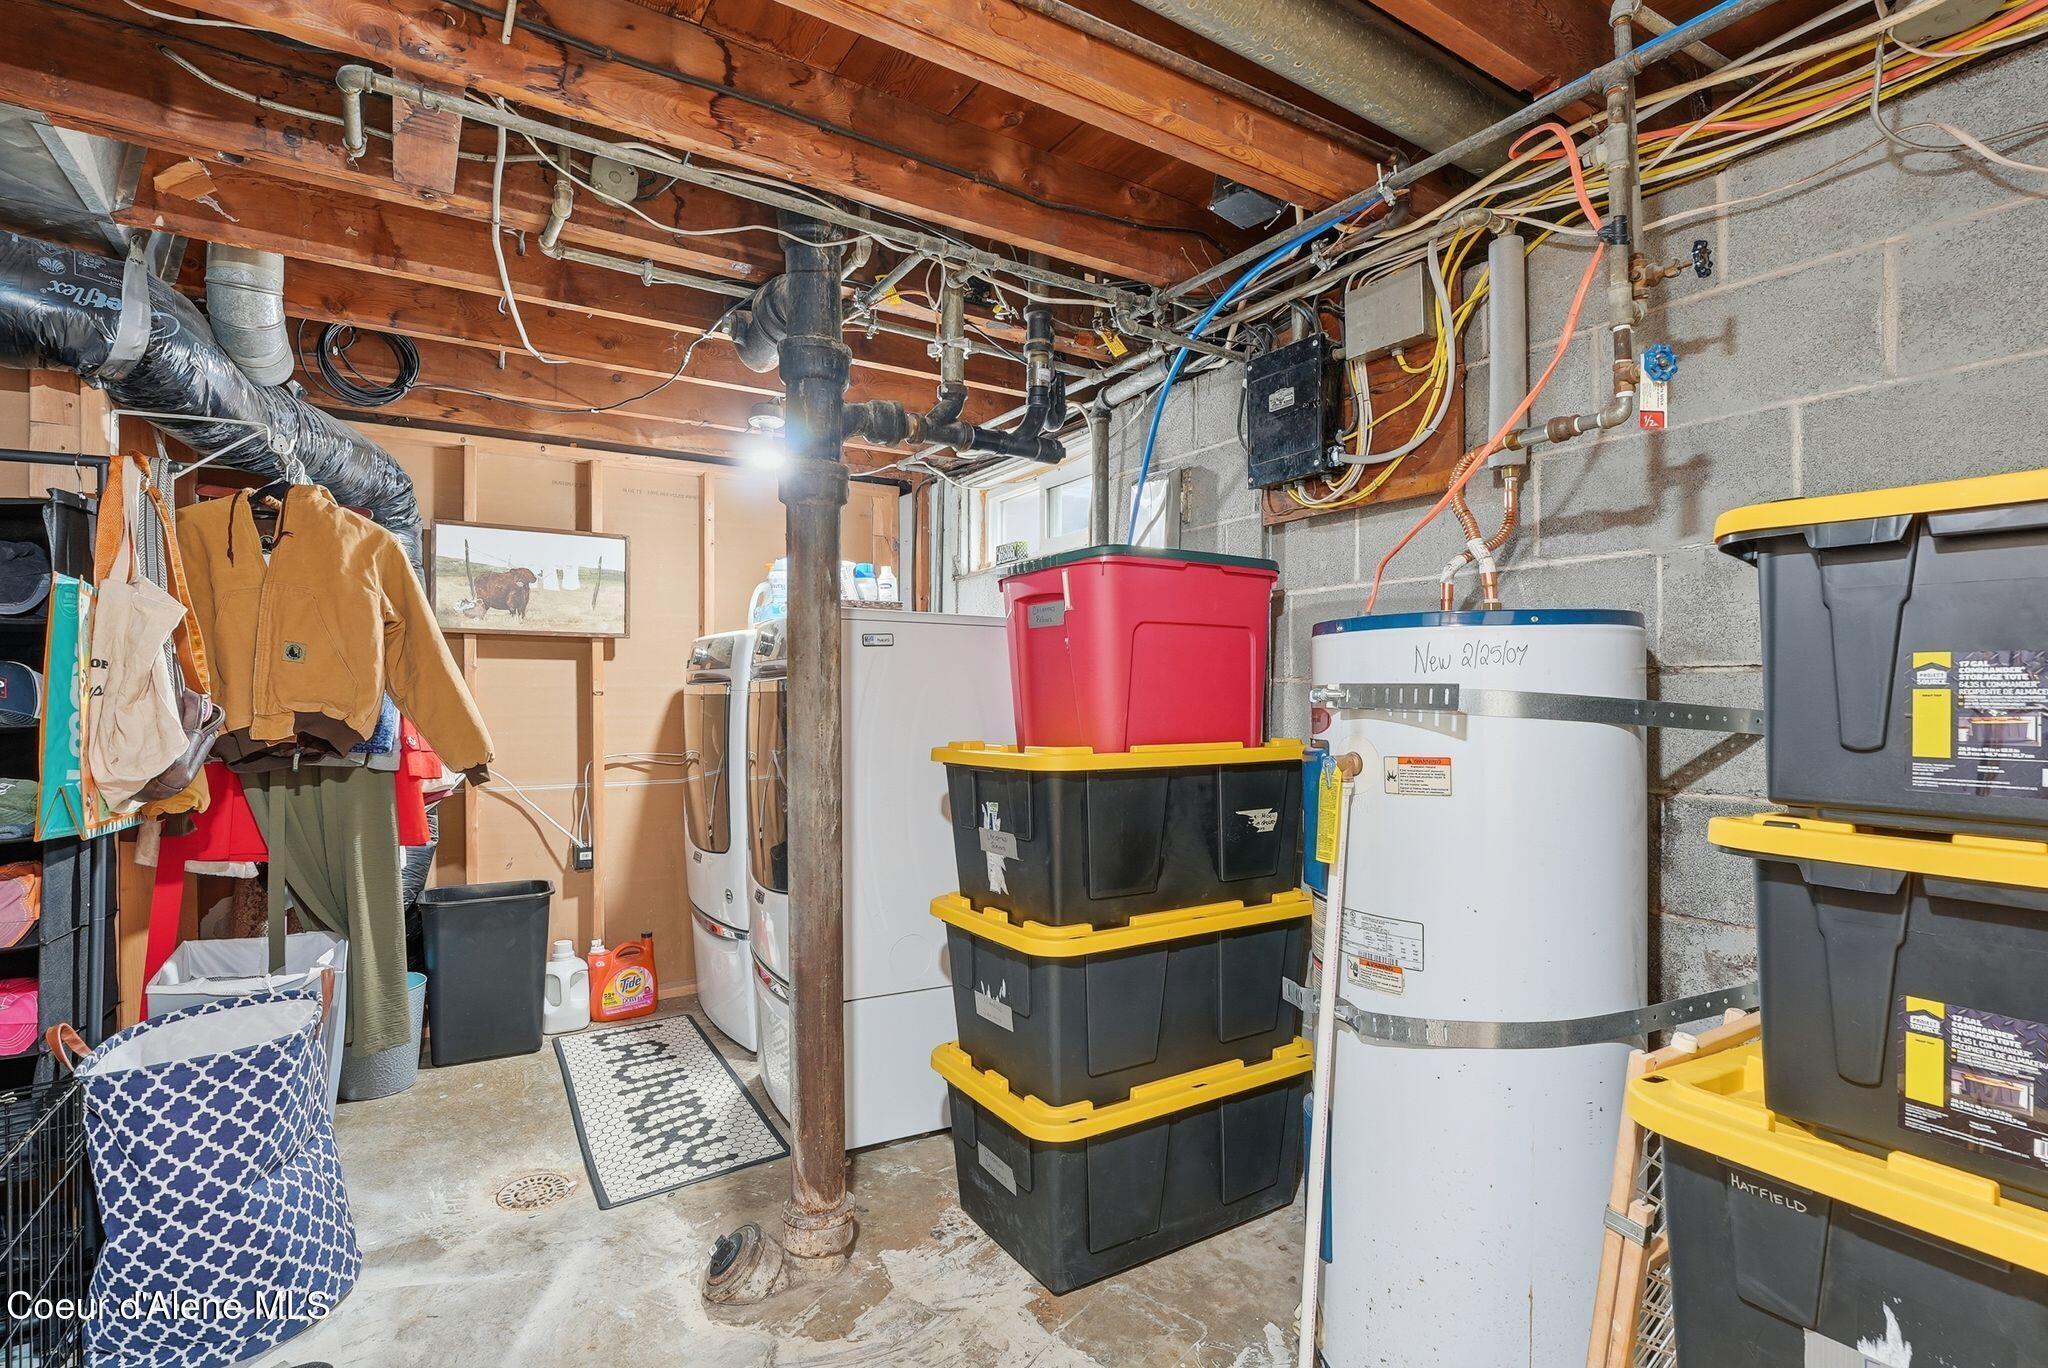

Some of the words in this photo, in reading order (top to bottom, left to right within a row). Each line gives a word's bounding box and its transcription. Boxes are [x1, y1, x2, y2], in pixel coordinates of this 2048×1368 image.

[1414, 641, 1452, 674] New
[1958, 666, 2024, 674] COMMANDER
[1958, 673, 2003, 681] STORAGE
[1958, 688, 2002, 696] RECIPIENTE
[1986, 681, 2038, 689] COMMANDER
[620, 976, 641, 993] Tide
[1963, 1016, 1983, 1027] GAL
[1951, 1021, 2016, 1041] COMMANDER
[1951, 1028, 1997, 1044] STORAGE
[1997, 1037, 2022, 1049] TOTE
[1951, 1041, 1995, 1058] RECIPIENTE
[1995, 1051, 2007, 1061] DE
[1979, 1041, 2031, 1059] COMMANDER
[590, 1024, 739, 1181] LAUNDRY
[1730, 1172, 1808, 1213] HATFIELD
